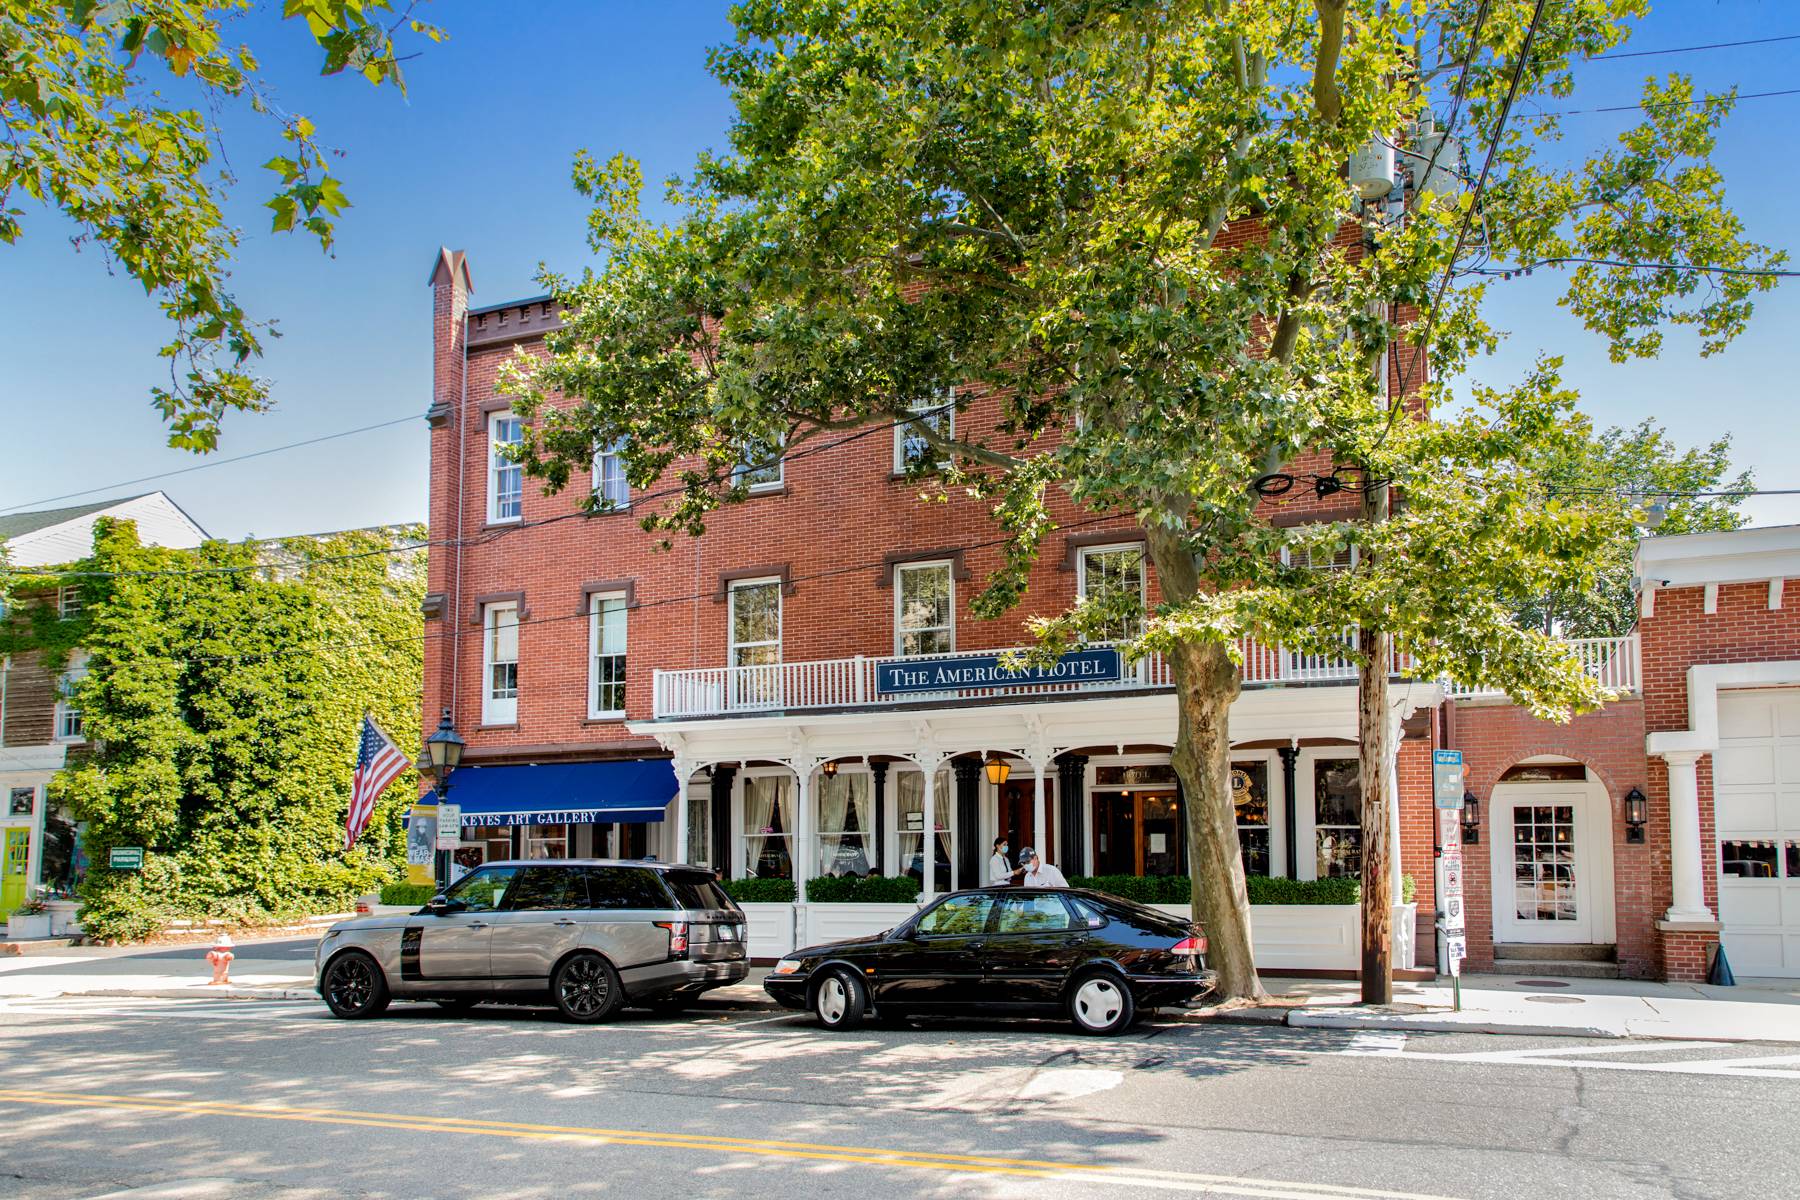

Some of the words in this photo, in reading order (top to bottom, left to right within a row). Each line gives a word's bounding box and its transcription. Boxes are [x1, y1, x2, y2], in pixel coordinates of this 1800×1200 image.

[889, 668, 929, 687] THE
[934, 665, 1031, 685] AMERICAN
[1036, 659, 1106, 678] HOTEL
[461, 815, 501, 827] KEYES
[506, 813, 531, 826] ART
[537, 811, 598, 825] GALLERY
